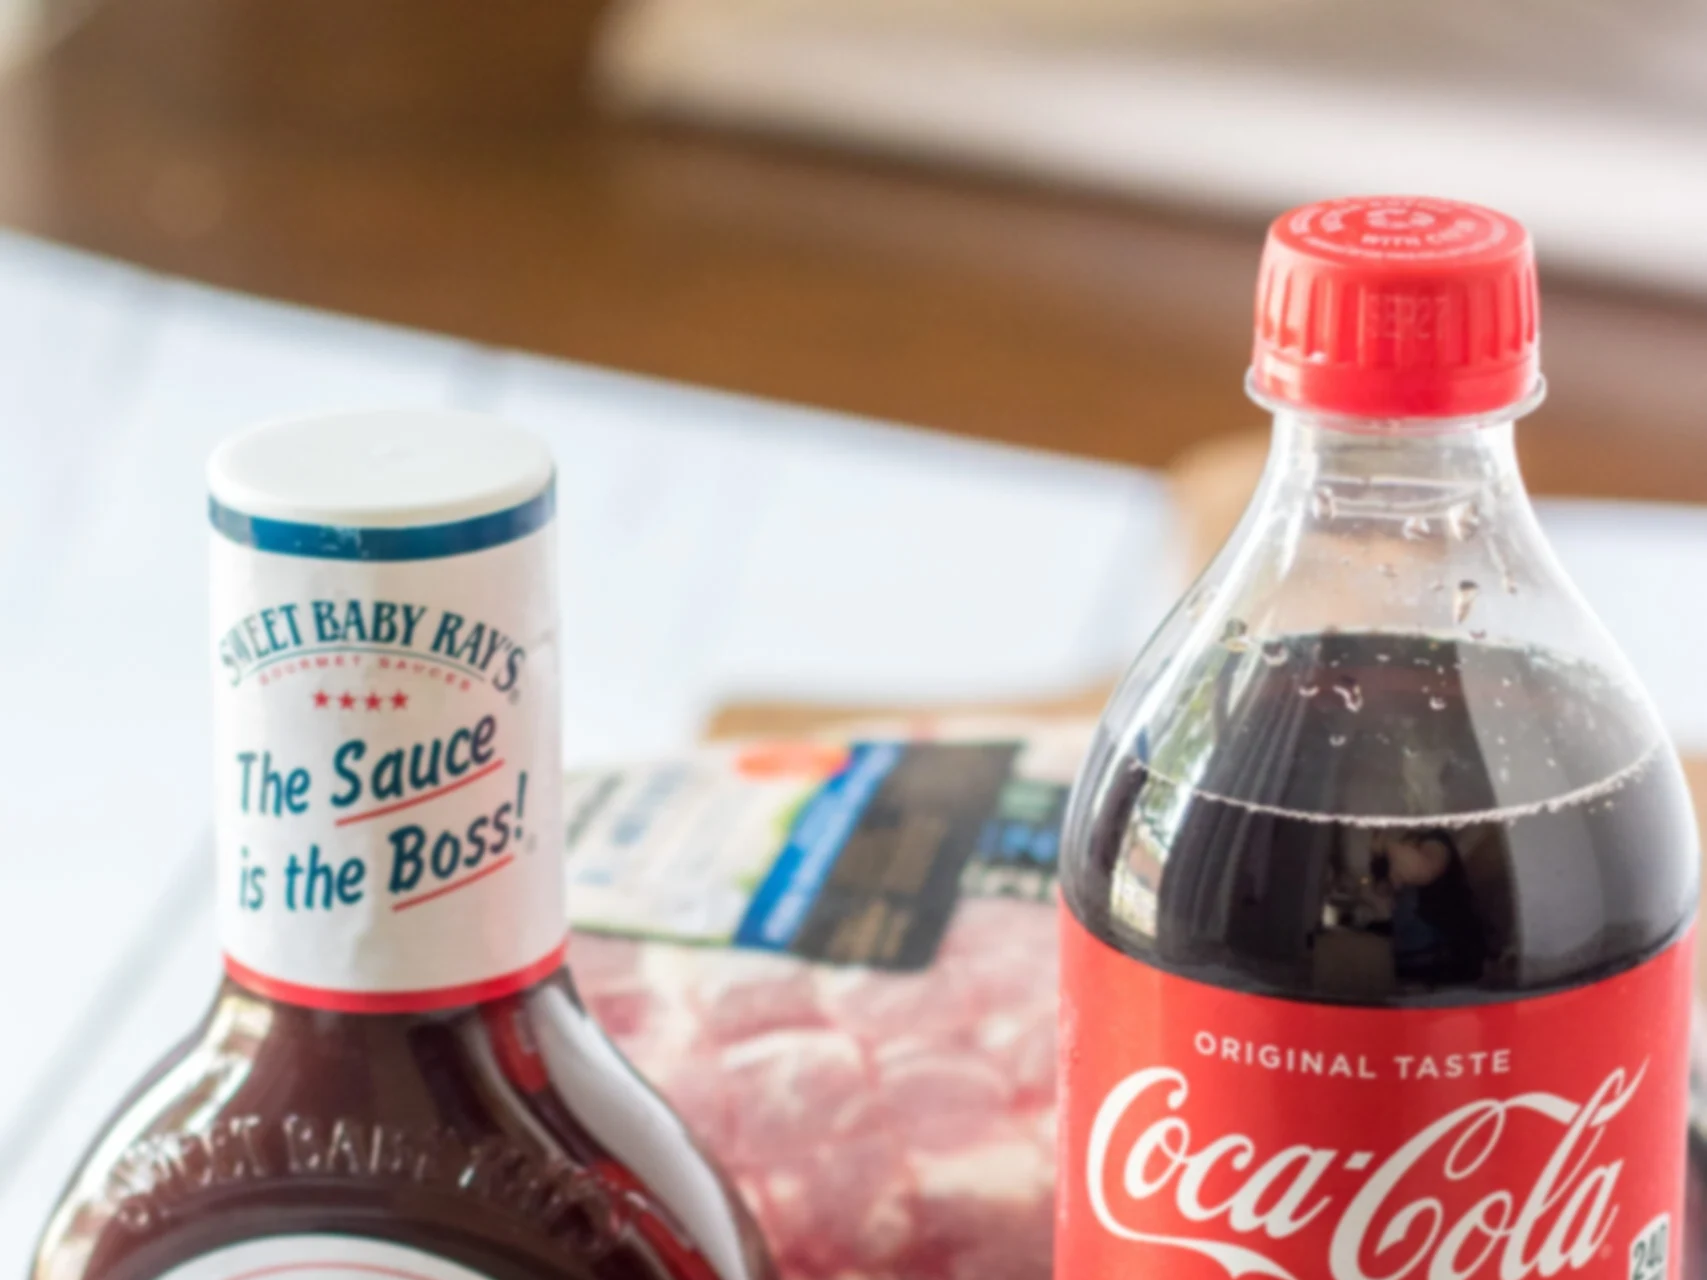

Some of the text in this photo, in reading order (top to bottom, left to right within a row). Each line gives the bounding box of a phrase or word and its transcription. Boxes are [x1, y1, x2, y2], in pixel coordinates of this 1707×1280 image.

[219, 600, 526, 693] SWEET BABY RAY'S
[236, 715, 496, 816] The Sauce
[240, 846, 265, 910] is
[284, 845, 366, 911] the
[387, 770, 528, 894] Boss!
[1195, 1030, 1512, 1080] ORIGINAL TASTE
